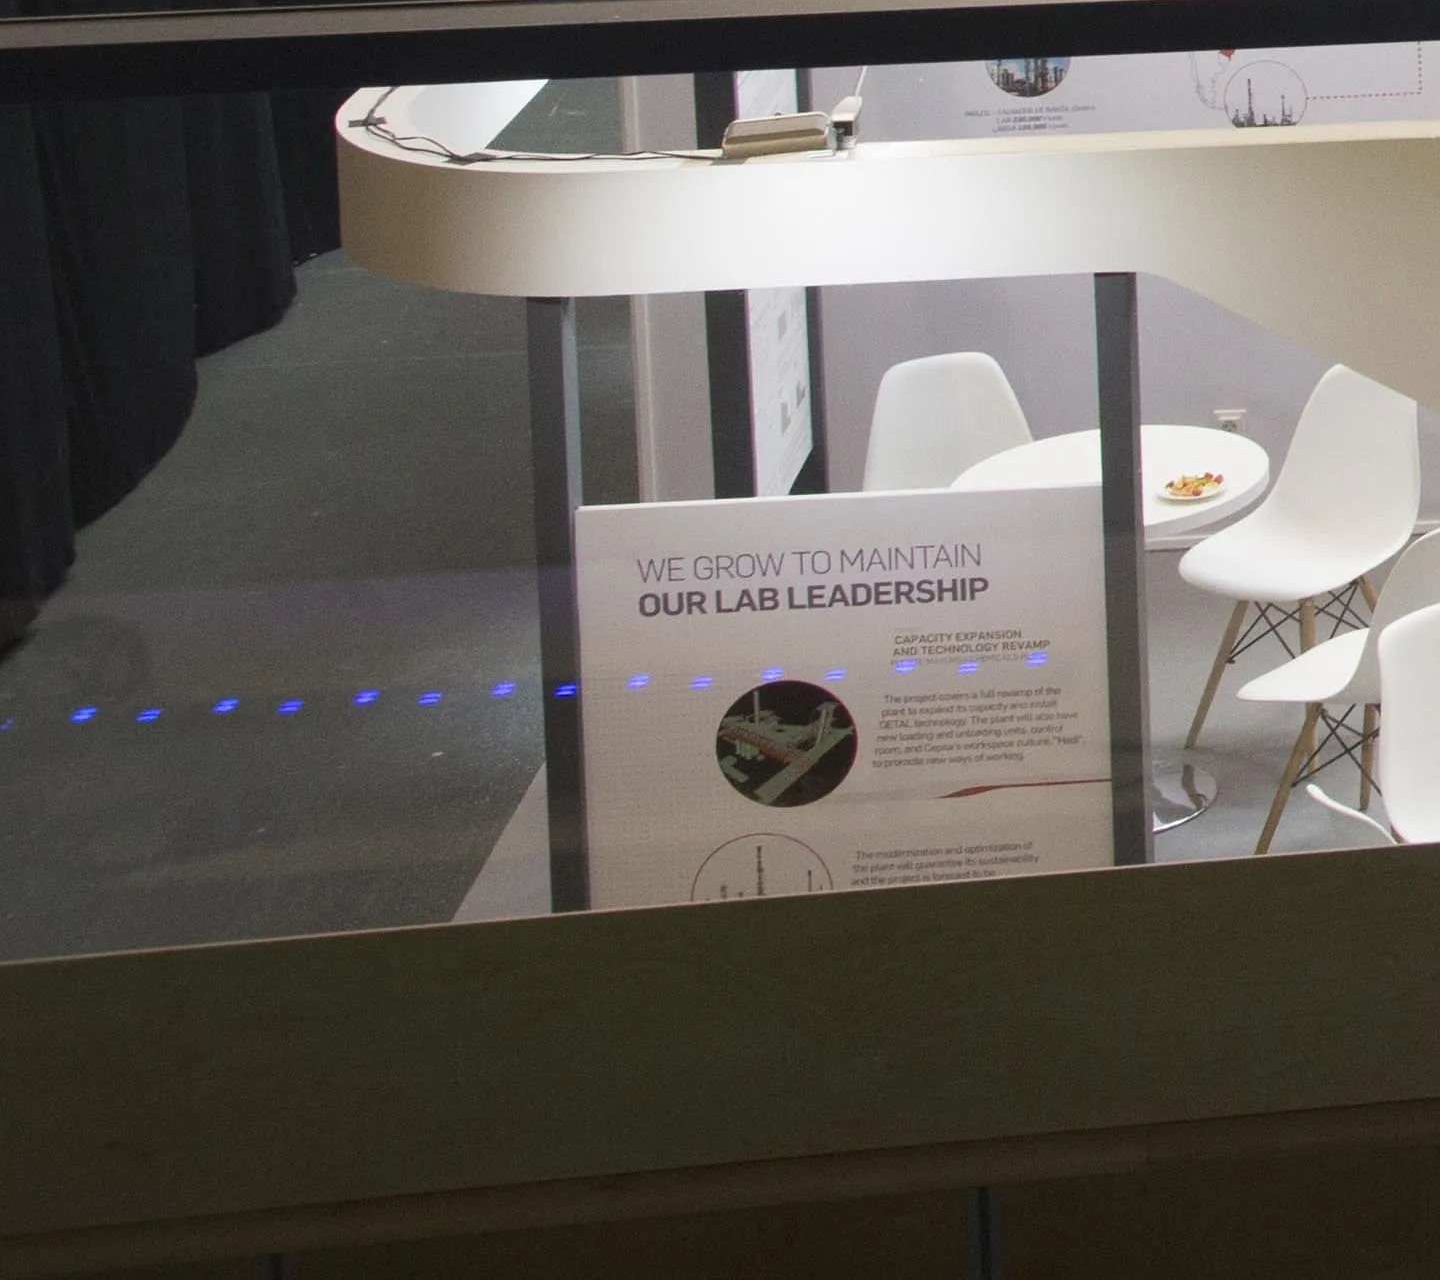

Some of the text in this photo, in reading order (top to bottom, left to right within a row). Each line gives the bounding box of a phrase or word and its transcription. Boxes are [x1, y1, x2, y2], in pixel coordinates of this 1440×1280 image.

[637, 543, 982, 583] WE GROW TO MAINTAIN
[638, 577, 989, 618] OUR LAB LEADERSHIP
[894, 629, 1022, 645] CAPACITY EXPANSION
[893, 639, 1050, 657] AND TECHNOLOGY REVAMP
[884, 694, 901, 703] The
[903, 692, 937, 704] project
[938, 691, 969, 701] covers
[980, 688, 995, 699] full
[997, 689, 1033, 700] revamp
[1035, 686, 1044, 696] of
[1045, 687, 1061, 696] the
[881, 699, 1057, 718] plant to expand its capacity and install
[971, 714, 986, 724] The
[990, 713, 1014, 725] plant
[1016, 712, 1031, 722] will
[1035, 711, 1055, 721] also
[1057, 711, 1079, 720] have
[877, 733, 897, 742] new
[900, 730, 934, 742] loading
[936, 729, 953, 739] and
[955, 727, 1000, 739] unloading
[1030, 723, 1063, 734] control
[904, 744, 922, 753] and
[964, 739, 1015, 752] workspace
[873, 759, 882, 768] to
[884, 756, 924, 768] promote
[926, 756, 946, 765] new
[949, 754, 973, 765] ways
[975, 752, 984, 762] of
[857, 841, 1033, 861] The modernization and optimization of
[853, 854, 1040, 874] the plant will guarantee its sustainability
[851, 876, 869, 886] and
[871, 875, 886, 884] the
[887, 873, 920, 885] project
[932, 869, 971, 880] forecast
[972, 869, 981, 878] to
